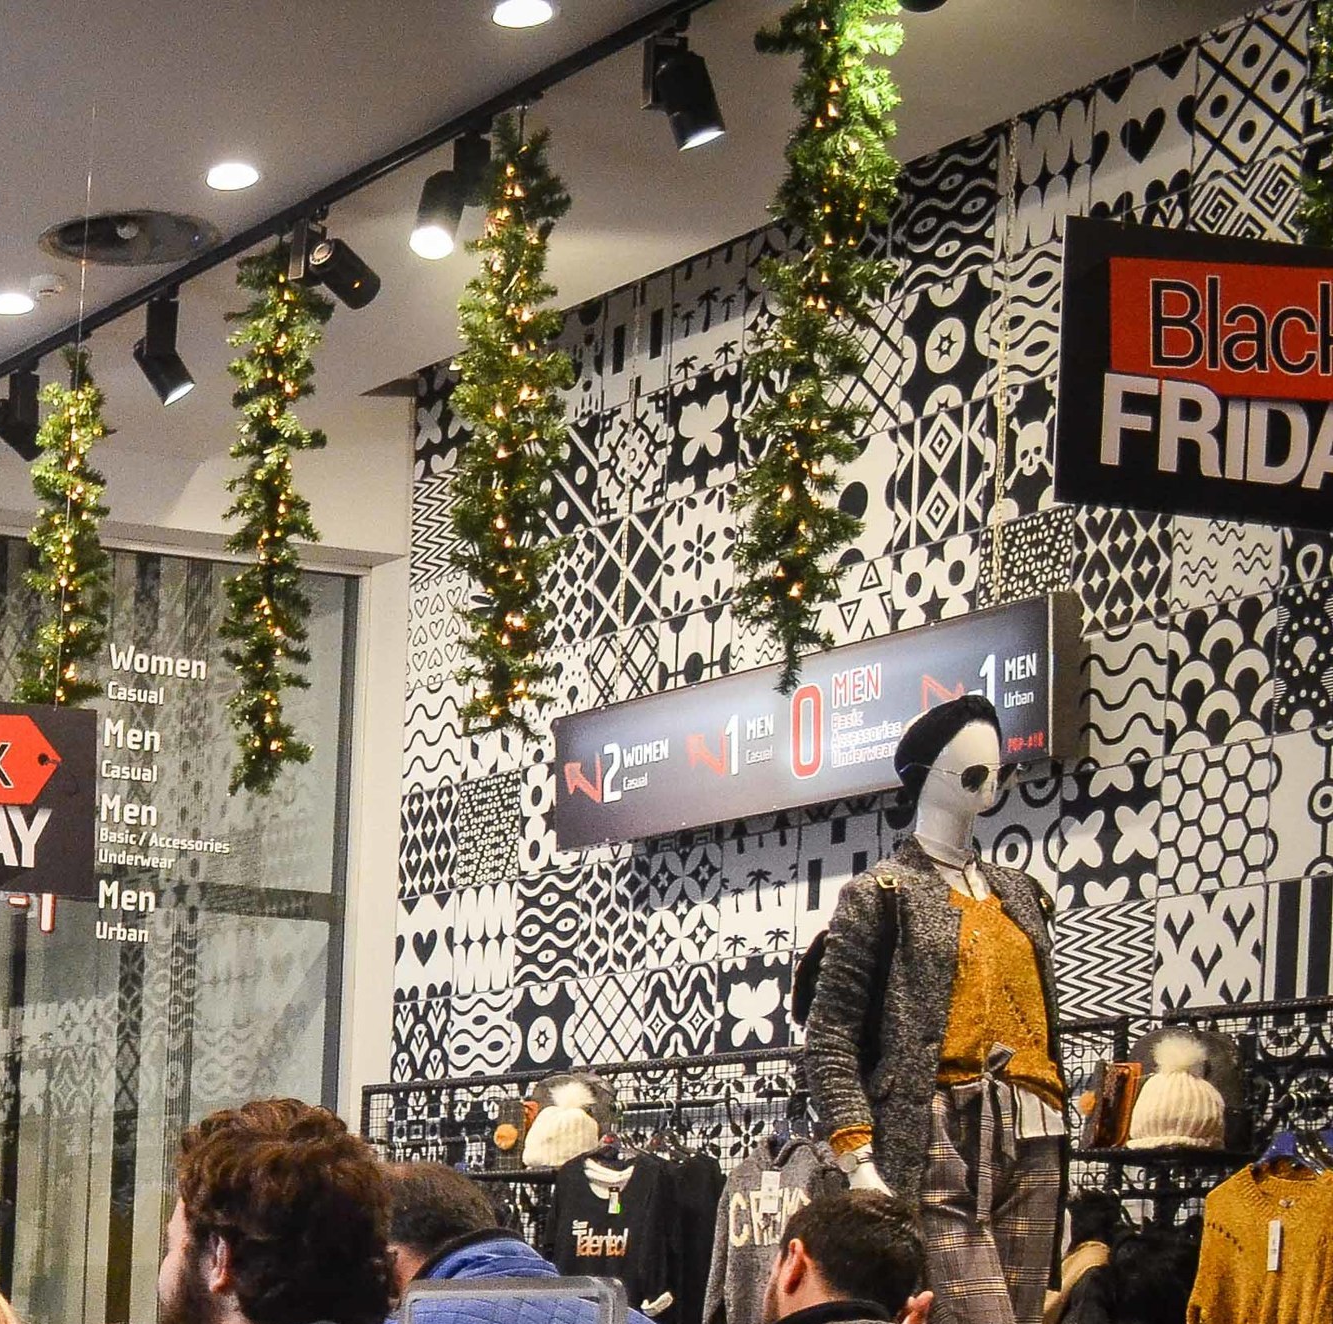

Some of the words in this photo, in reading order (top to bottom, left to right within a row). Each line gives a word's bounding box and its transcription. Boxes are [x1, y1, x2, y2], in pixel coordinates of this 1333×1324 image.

[110, 643, 207, 680] Women
[1004, 652, 1037, 683] MEN
[107, 680, 165, 706] Casual
[831, 663, 882, 709] MEN
[1003, 690, 1035, 709] Urban
[103, 718, 162, 753] Men
[724, 713, 739, 776] 1
[745, 713, 774, 741] MEN
[101, 759, 158, 783] Casual
[603, 742, 622, 803] 2
[622, 738, 669, 769] WOMEN
[100, 793, 158, 827] Men
[99, 827, 137, 846] Basic
[148, 832, 231, 855] Accessories
[98, 848, 176, 870] Underwear
[98, 879, 156, 913] Men
[95, 921, 150, 943] Urban
